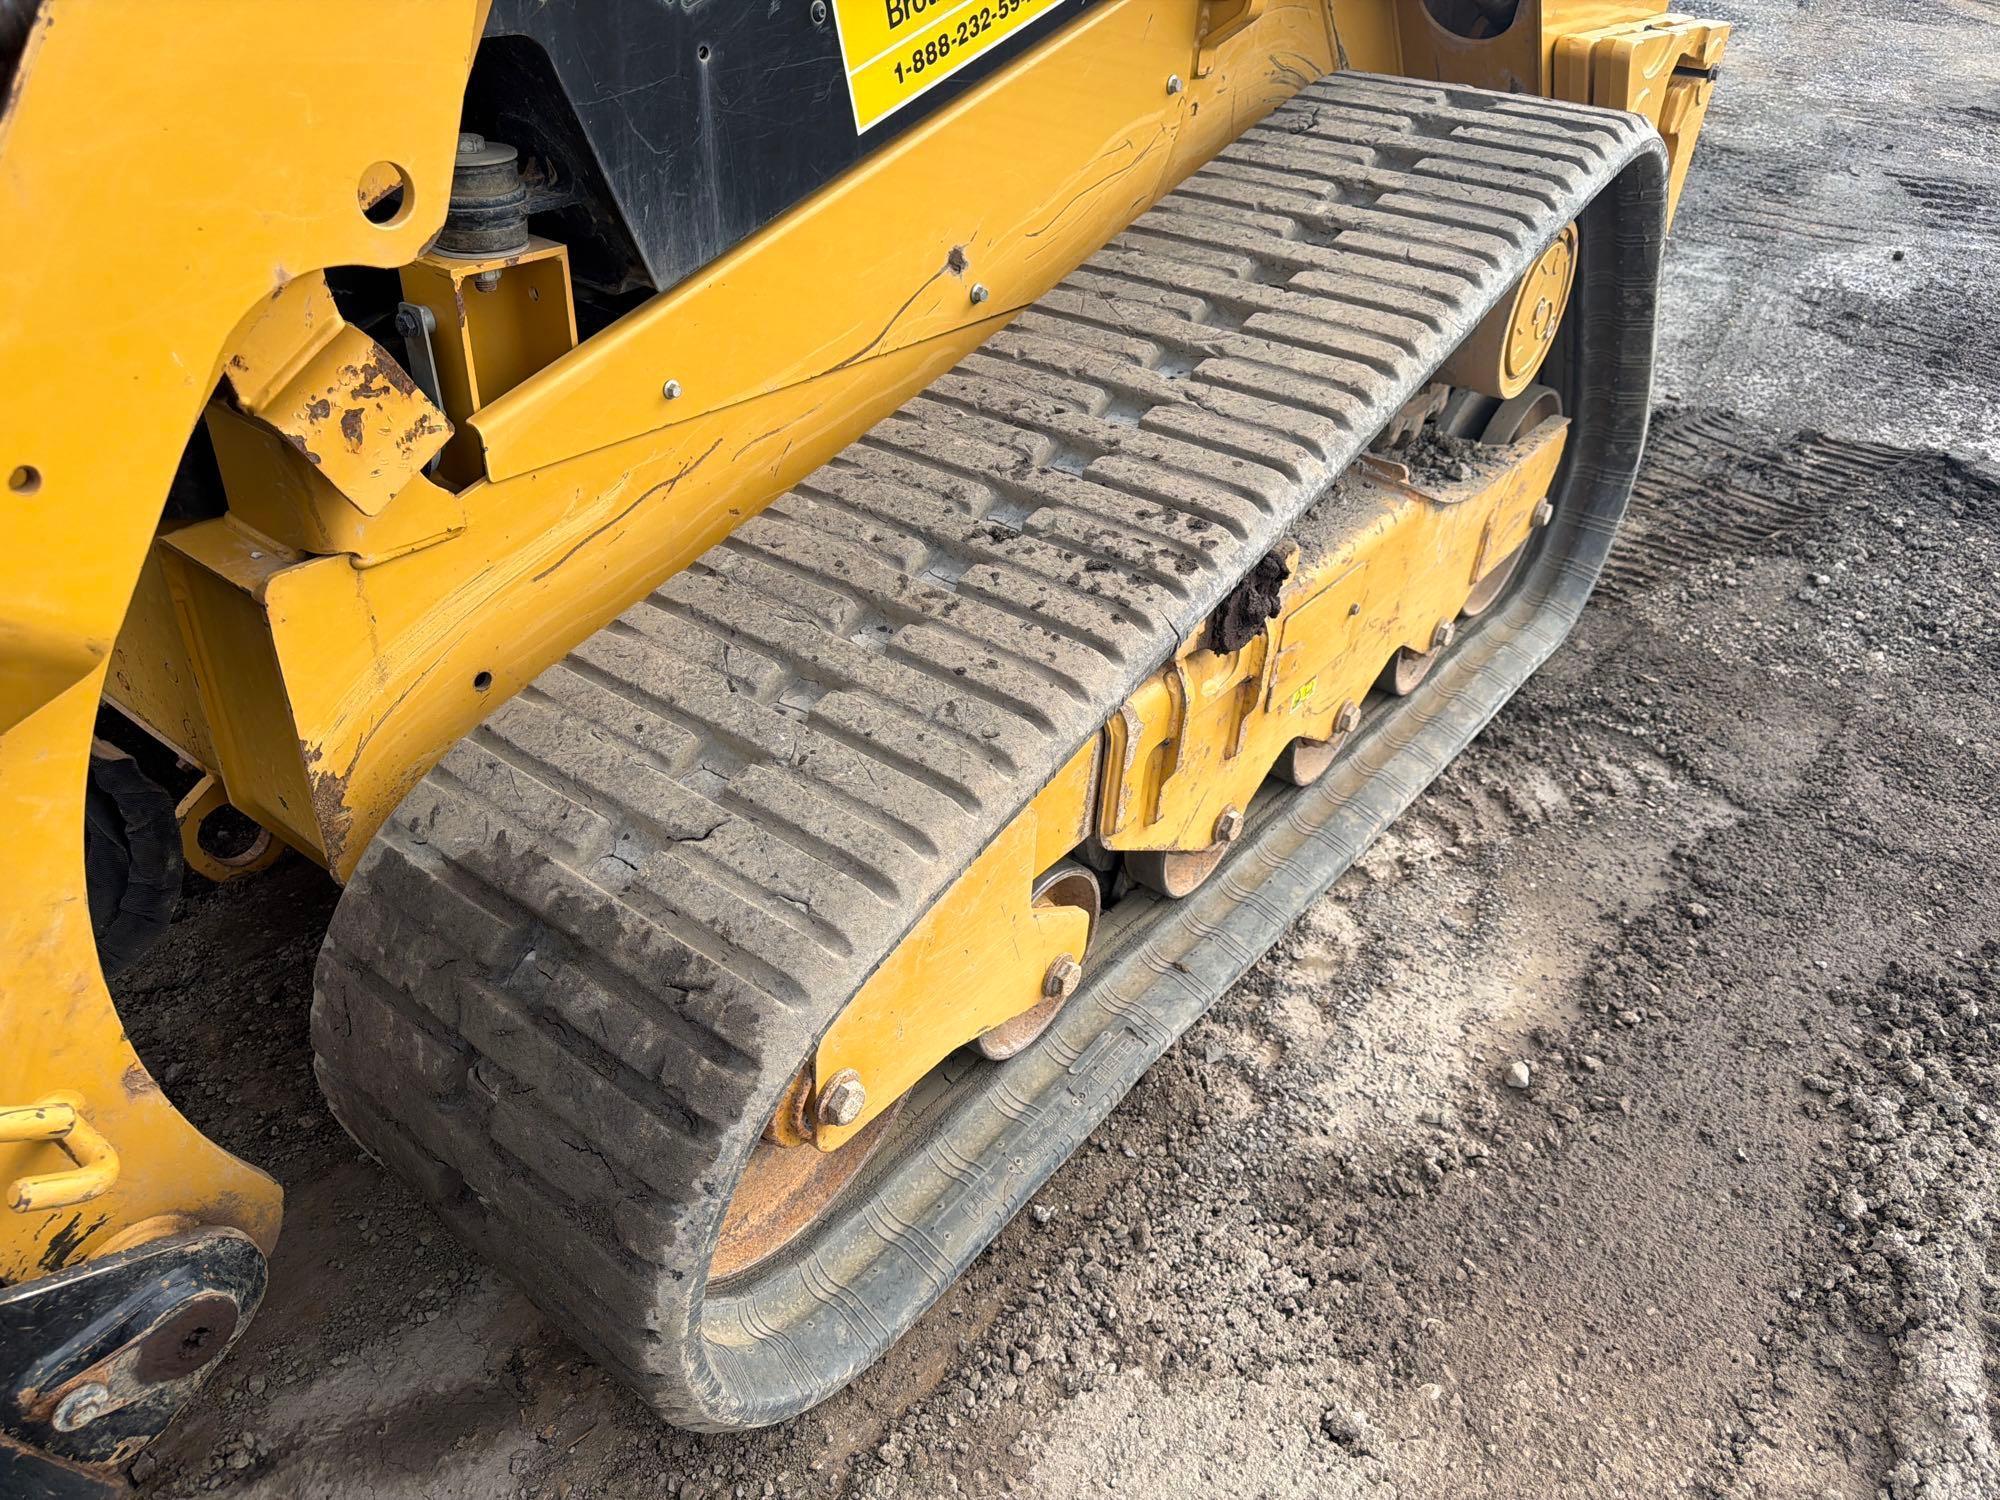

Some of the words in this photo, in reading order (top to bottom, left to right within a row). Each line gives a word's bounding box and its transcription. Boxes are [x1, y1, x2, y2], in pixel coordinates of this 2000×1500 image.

[886, 0, 939, 29] Bro
[894, 0, 1030, 84] 1-888-232-59
[960, 1181, 999, 1222] CAT
